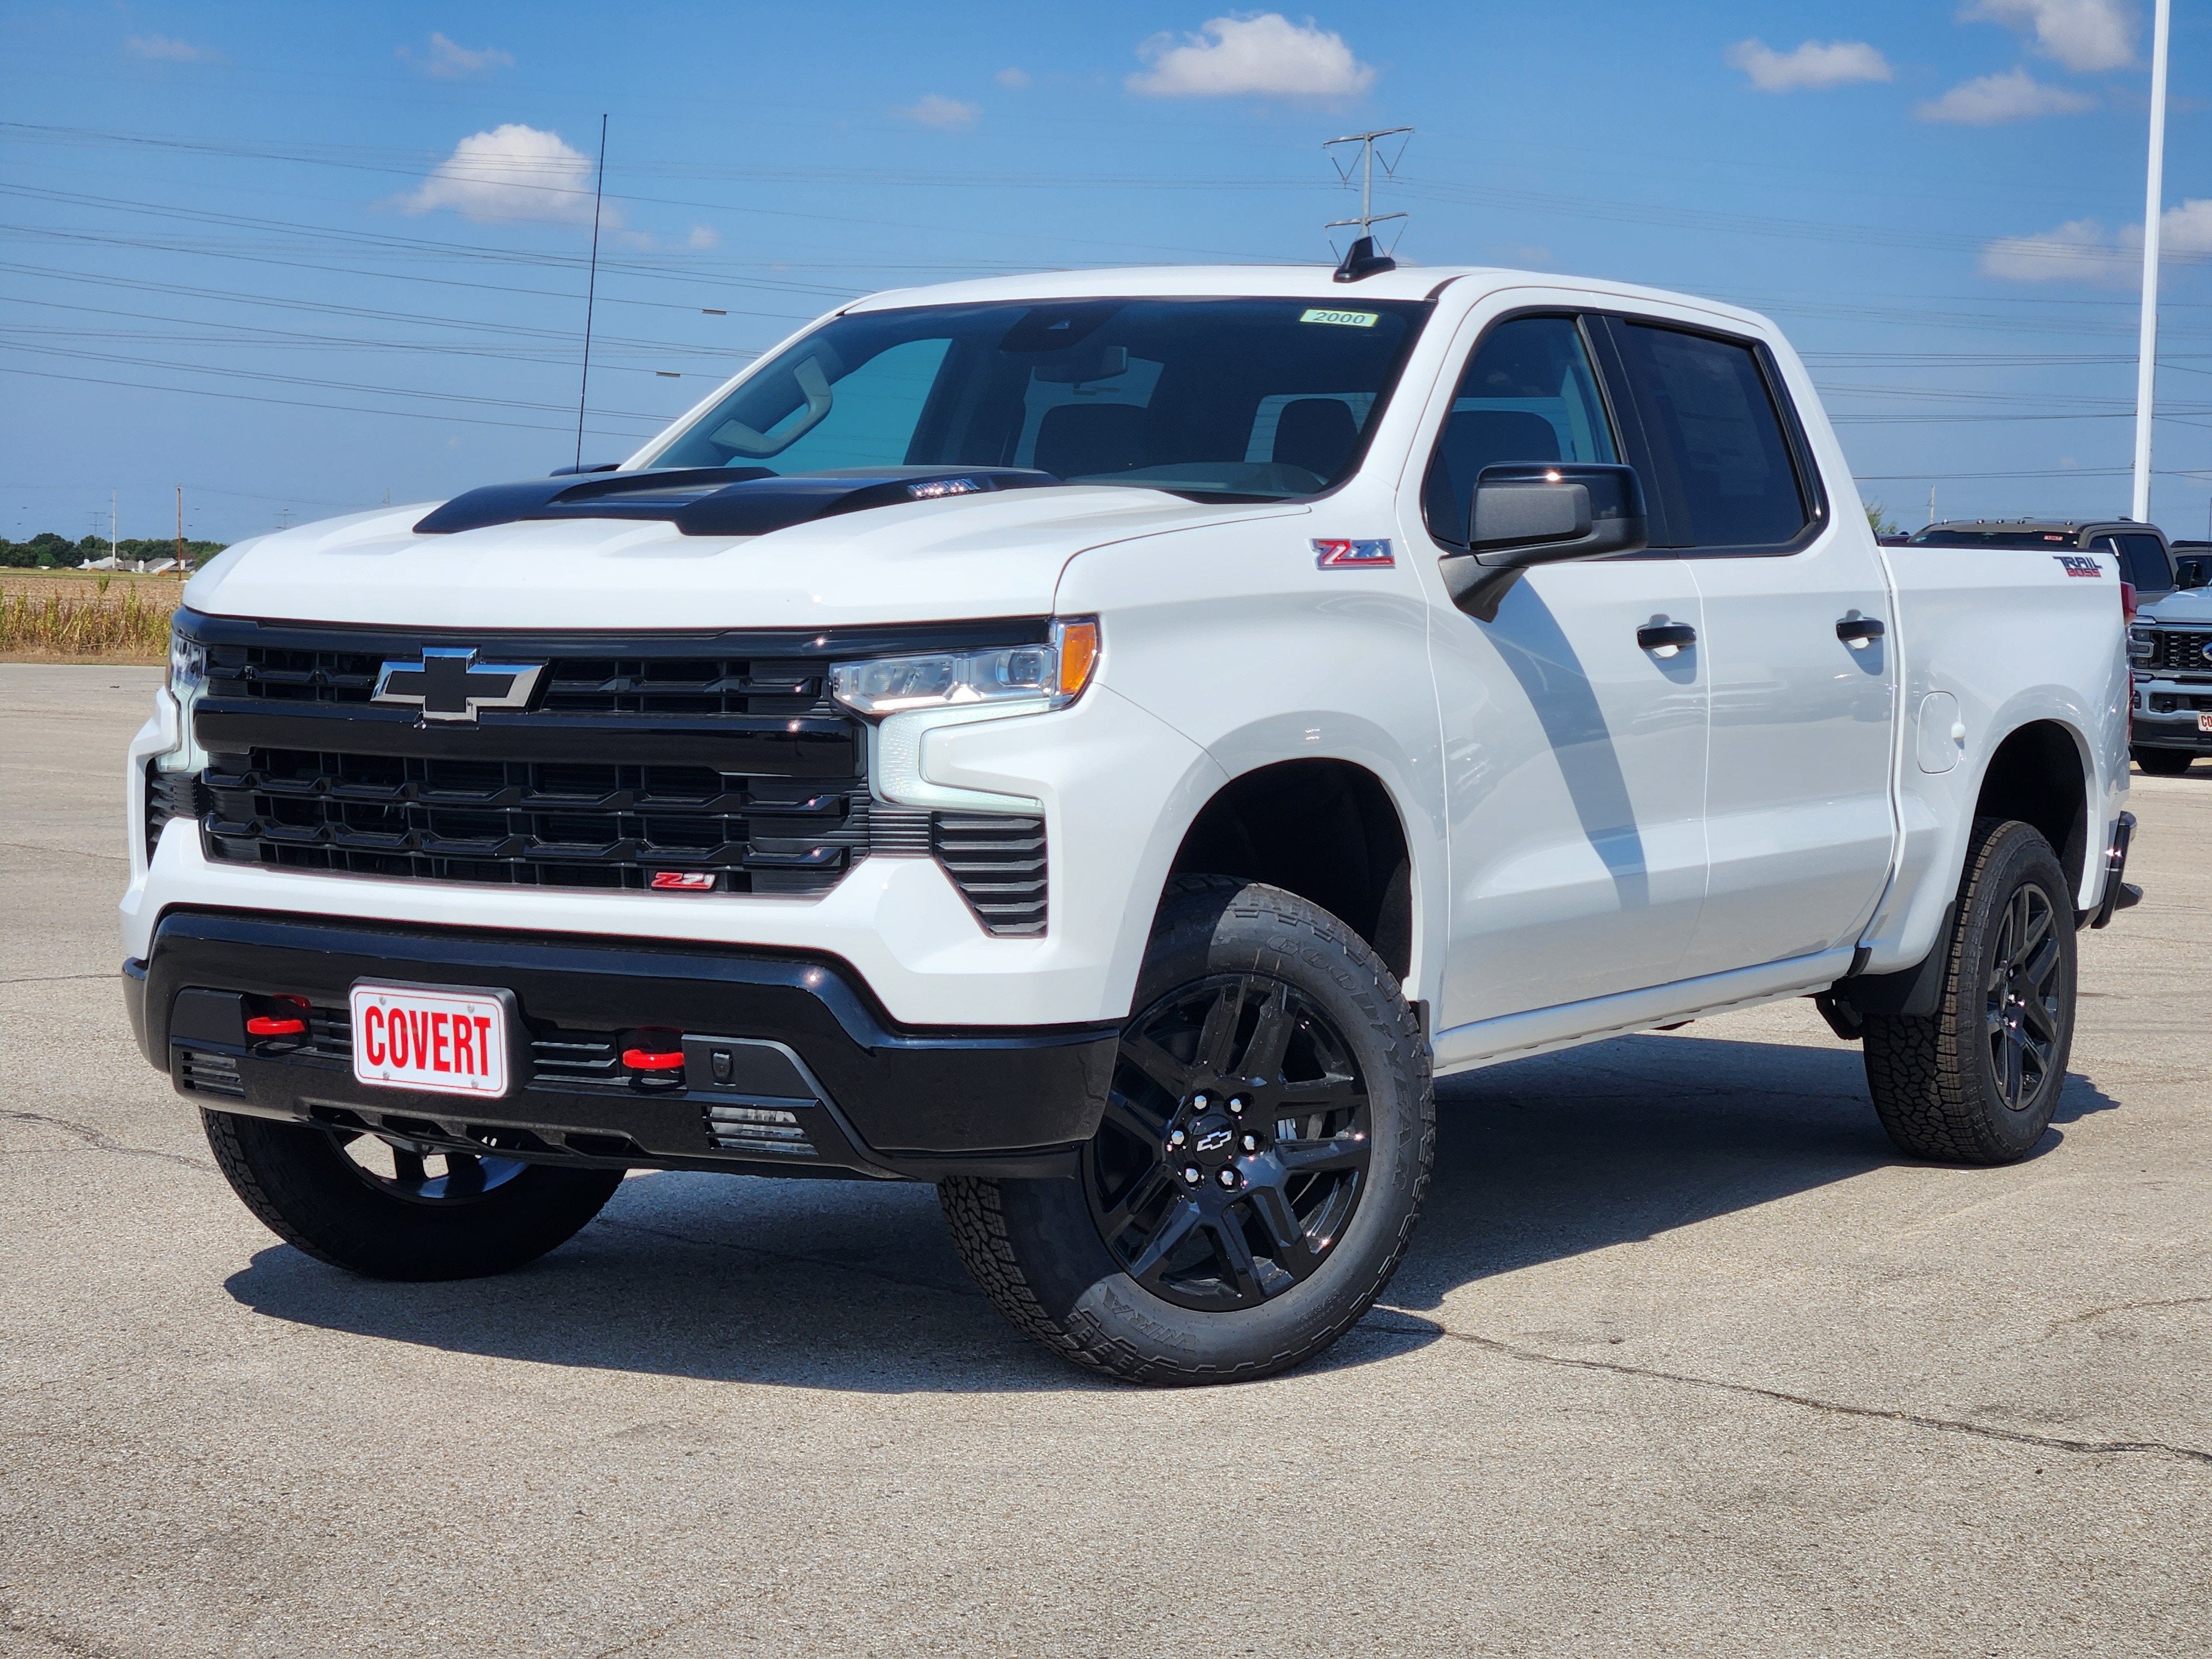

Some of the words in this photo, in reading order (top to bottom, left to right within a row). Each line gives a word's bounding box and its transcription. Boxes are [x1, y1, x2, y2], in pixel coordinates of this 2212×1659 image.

[1312, 311, 1365, 324] 2000
[2052, 556, 2103, 568] TRAIL
[2066, 568, 2101, 577] BOSS
[651, 872, 716, 889] Z71
[364, 1005, 491, 1076] COVERT
